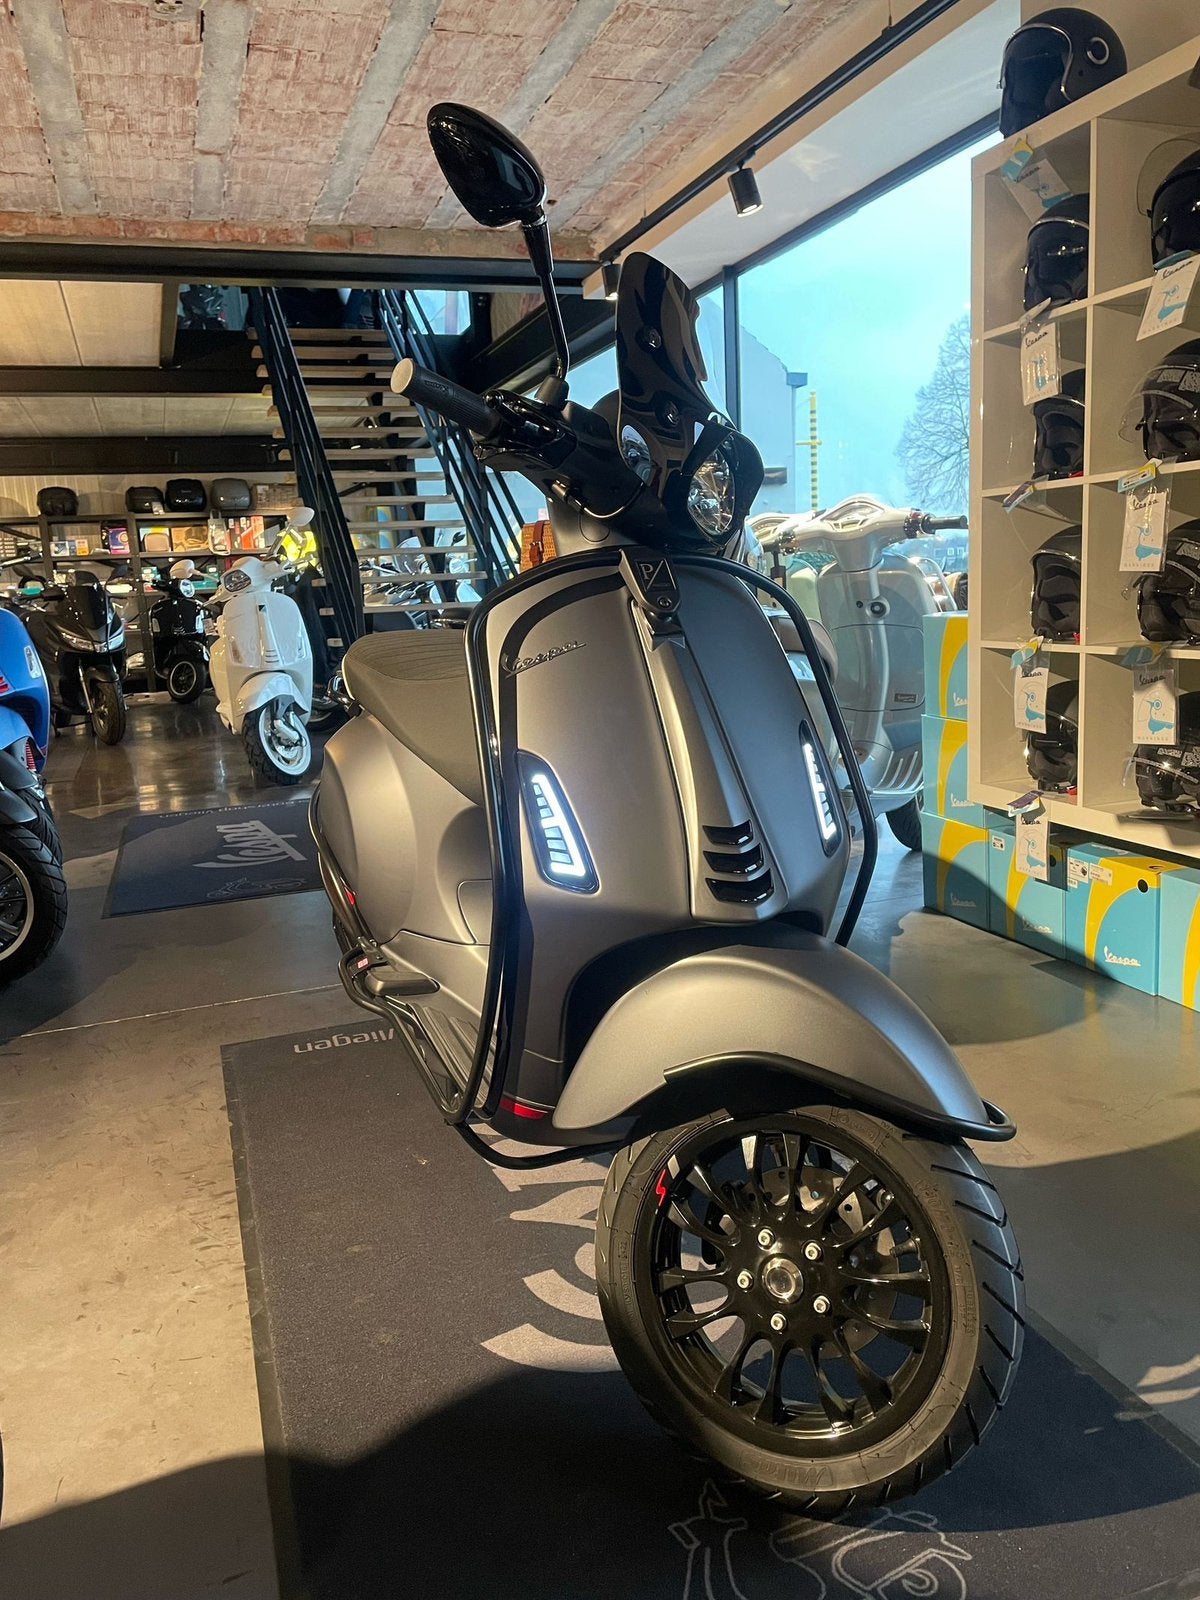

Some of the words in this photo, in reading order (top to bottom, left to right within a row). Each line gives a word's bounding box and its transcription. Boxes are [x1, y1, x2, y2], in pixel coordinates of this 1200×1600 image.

[1025, 331, 1049, 349] Vespa
[1132, 498, 1159, 511] Vespa
[501, 640, 587, 679] Vespa
[1139, 674, 1166, 686] Vespa
[953, 692, 968, 707] Ves
[1021, 915, 1053, 934] Vespa
[1103, 945, 1142, 967] Vespa
